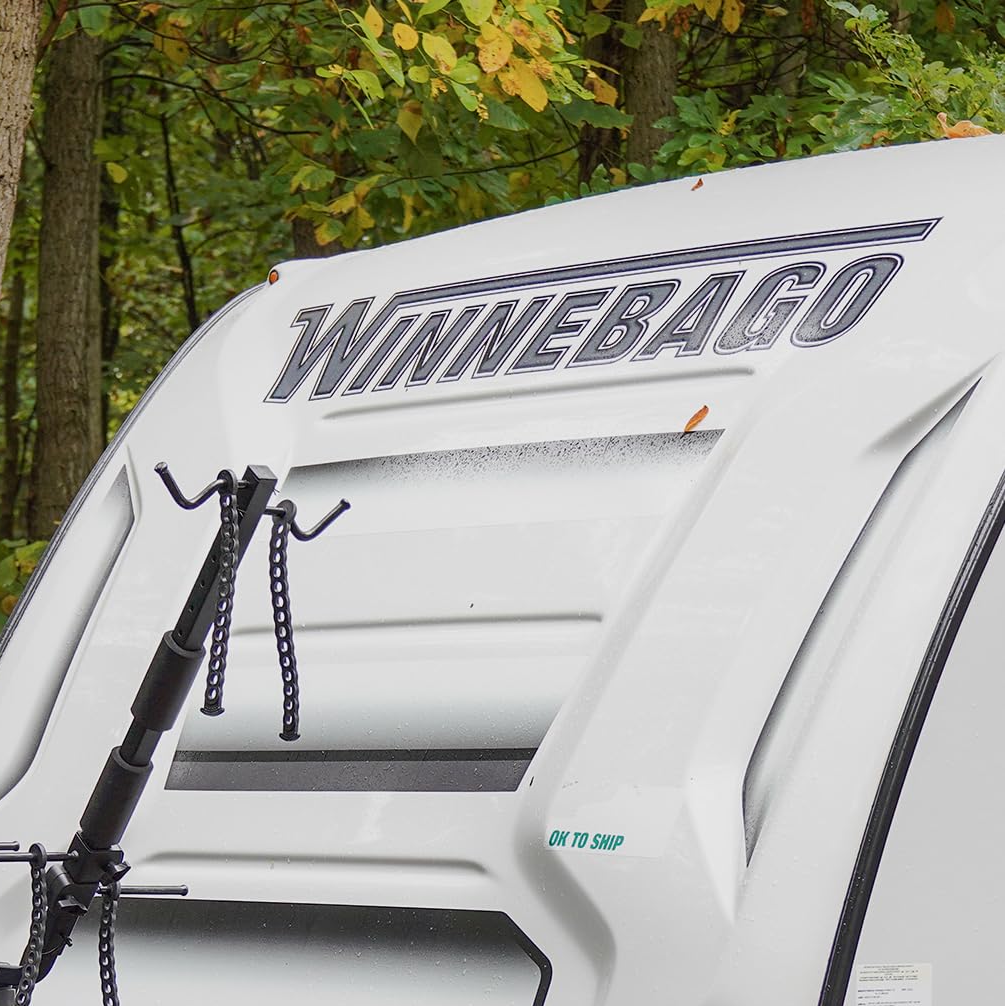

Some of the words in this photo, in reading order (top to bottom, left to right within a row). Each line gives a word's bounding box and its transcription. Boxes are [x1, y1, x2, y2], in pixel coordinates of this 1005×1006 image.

[263, 245, 906, 404] WINNEBAGO
[548, 829, 570, 847] OK
[571, 831, 589, 849] TO
[590, 833, 625, 851] SHIP
